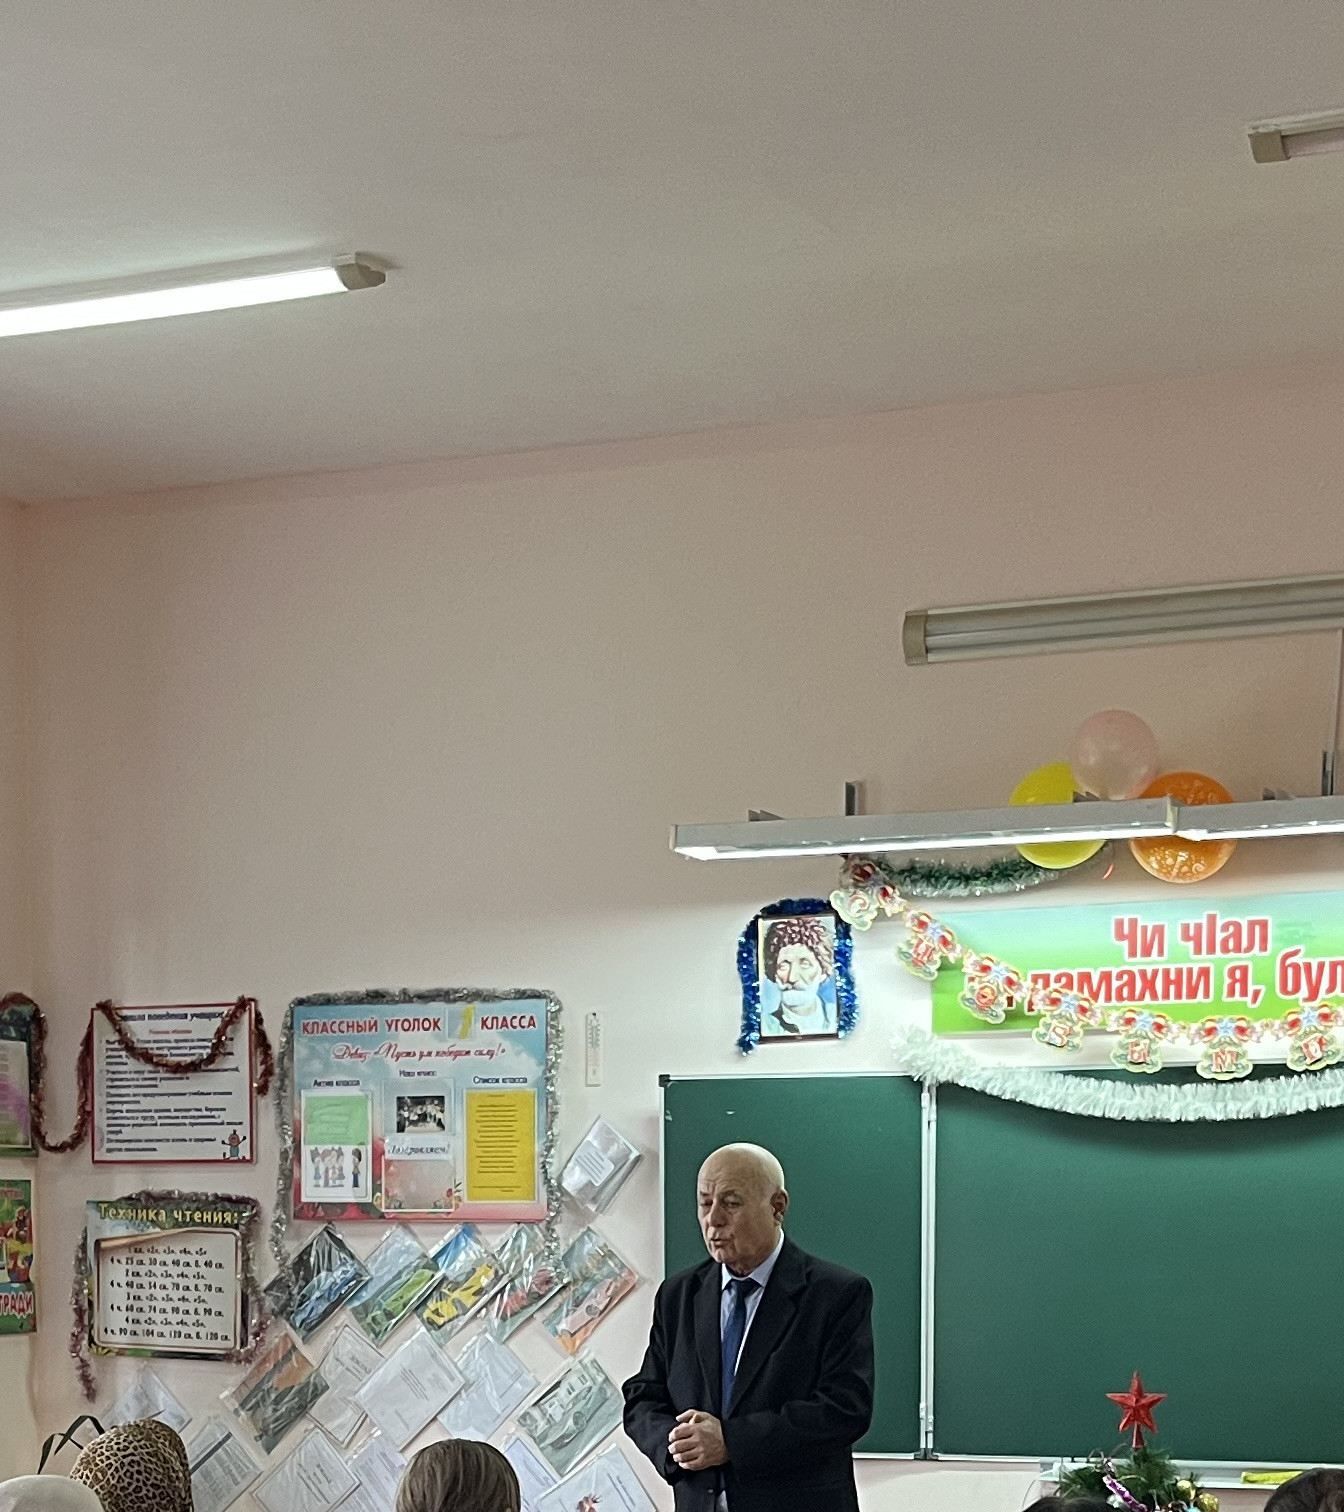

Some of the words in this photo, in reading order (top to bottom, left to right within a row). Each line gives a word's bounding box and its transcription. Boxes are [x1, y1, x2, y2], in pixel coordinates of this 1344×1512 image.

[1114, 917, 1165, 960] Чи
[1226, 964, 1265, 1006] я,
[302, 1017, 378, 1034] КЛАССНЫЙ
[385, 1017, 441, 1032] УГОЛОК
[481, 1015, 537, 1031] КЛАССА
[336, 1079, 360, 1088] класса
[473, 1076, 500, 1085] Список
[501, 1077, 528, 1086] класса
[99, 1202, 167, 1222] Техника
[174, 1208, 238, 1224] чтения:
